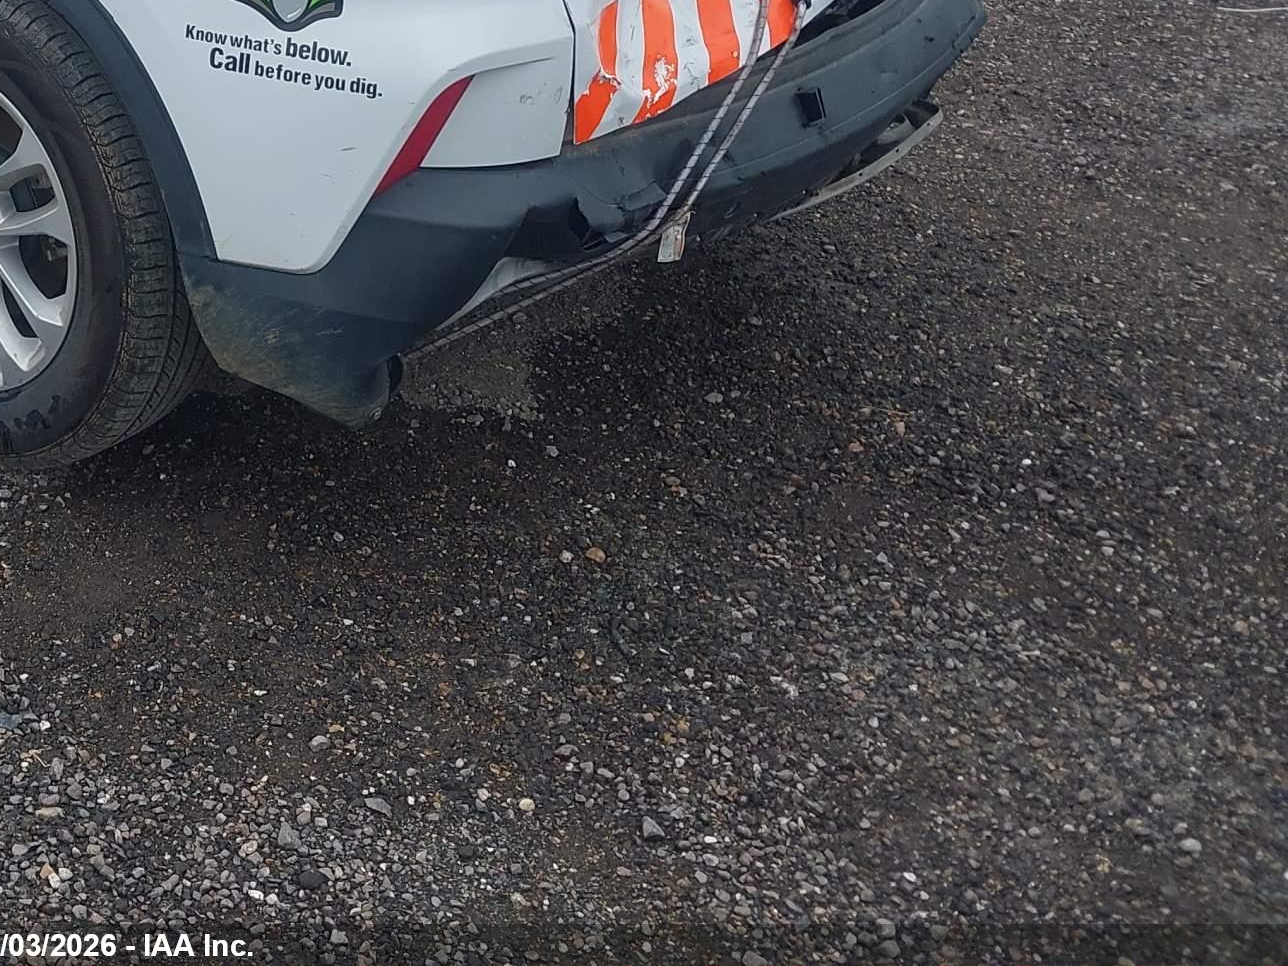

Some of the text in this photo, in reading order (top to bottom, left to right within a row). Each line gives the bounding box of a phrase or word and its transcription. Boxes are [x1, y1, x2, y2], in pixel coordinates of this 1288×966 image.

[185, 24, 352, 67] Know what's below.
[209, 47, 383, 99] Call before you dig.
